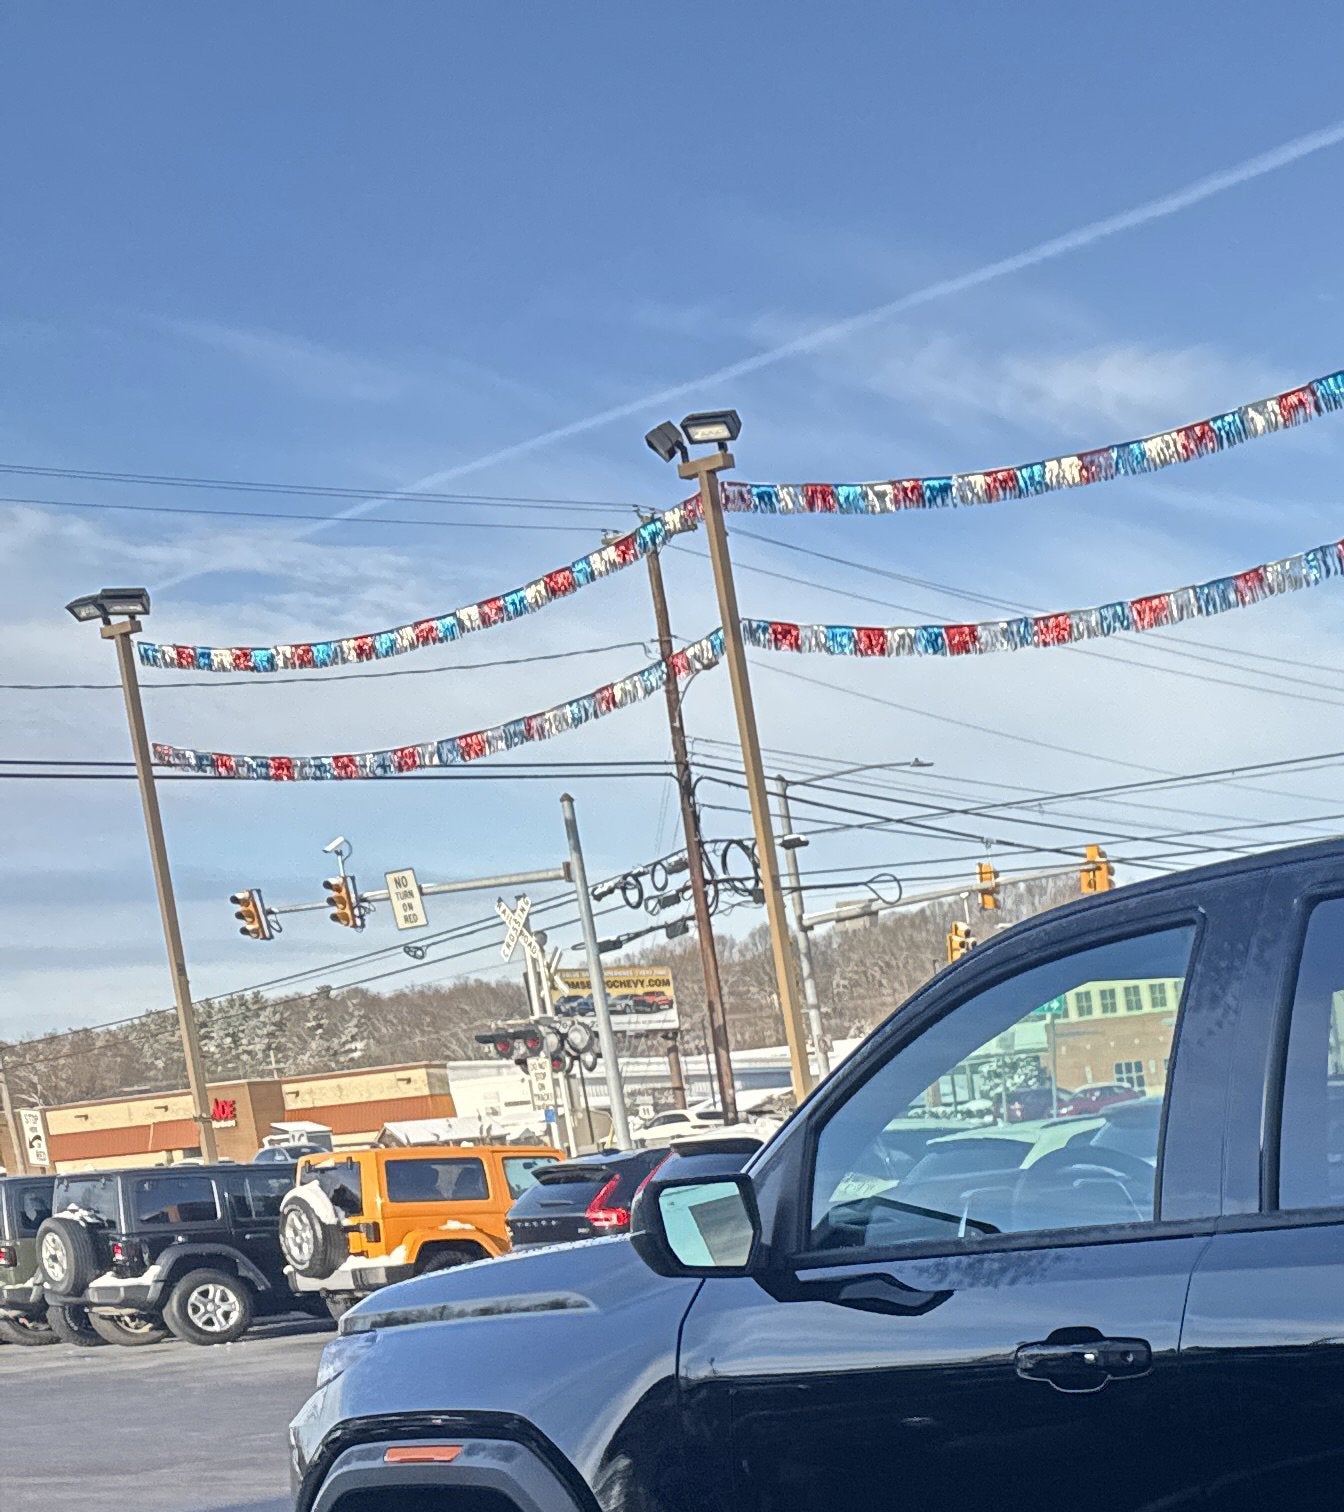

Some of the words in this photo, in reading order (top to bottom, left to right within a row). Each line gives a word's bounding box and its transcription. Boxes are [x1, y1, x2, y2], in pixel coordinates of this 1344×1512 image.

[394, 876, 408, 889] NO
[395, 890, 415, 900] TURN
[402, 902, 413, 912] ON
[404, 913, 418, 924] RED
